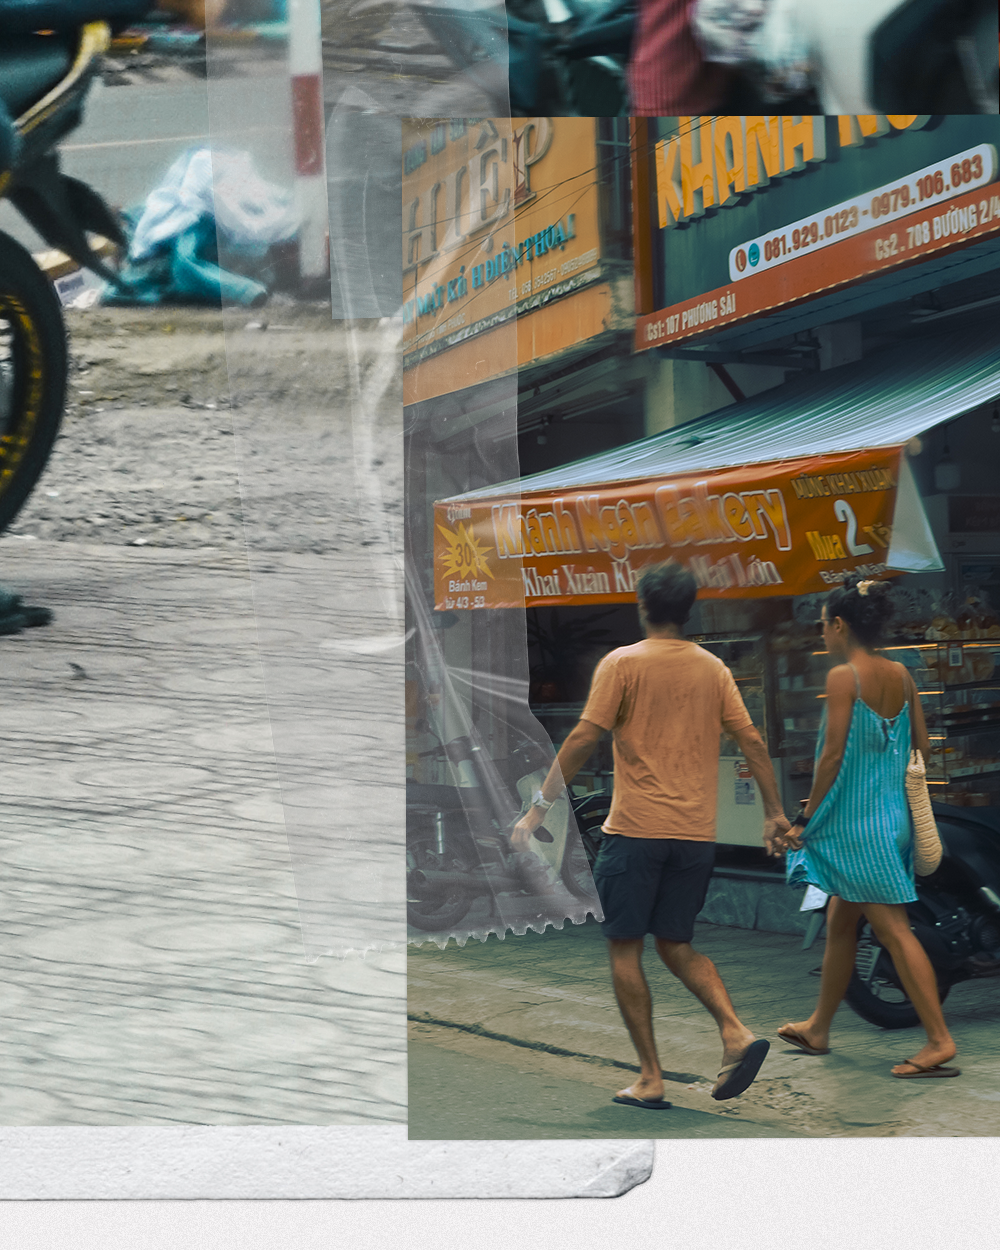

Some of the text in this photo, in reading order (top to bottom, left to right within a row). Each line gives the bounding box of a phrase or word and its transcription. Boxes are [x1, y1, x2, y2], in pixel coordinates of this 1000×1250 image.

[764, 206, 859, 262] 081.929.0123
[871, 154, 983, 219] 0979.106.683
[906, 220, 930, 249] 708
[492, 498, 582, 559] Khánh
[805, 530, 848, 561] Mua
[834, 499, 875, 557] 2
[521, 567, 562, 596] Khai
[561, 564, 610, 595] Xuân
